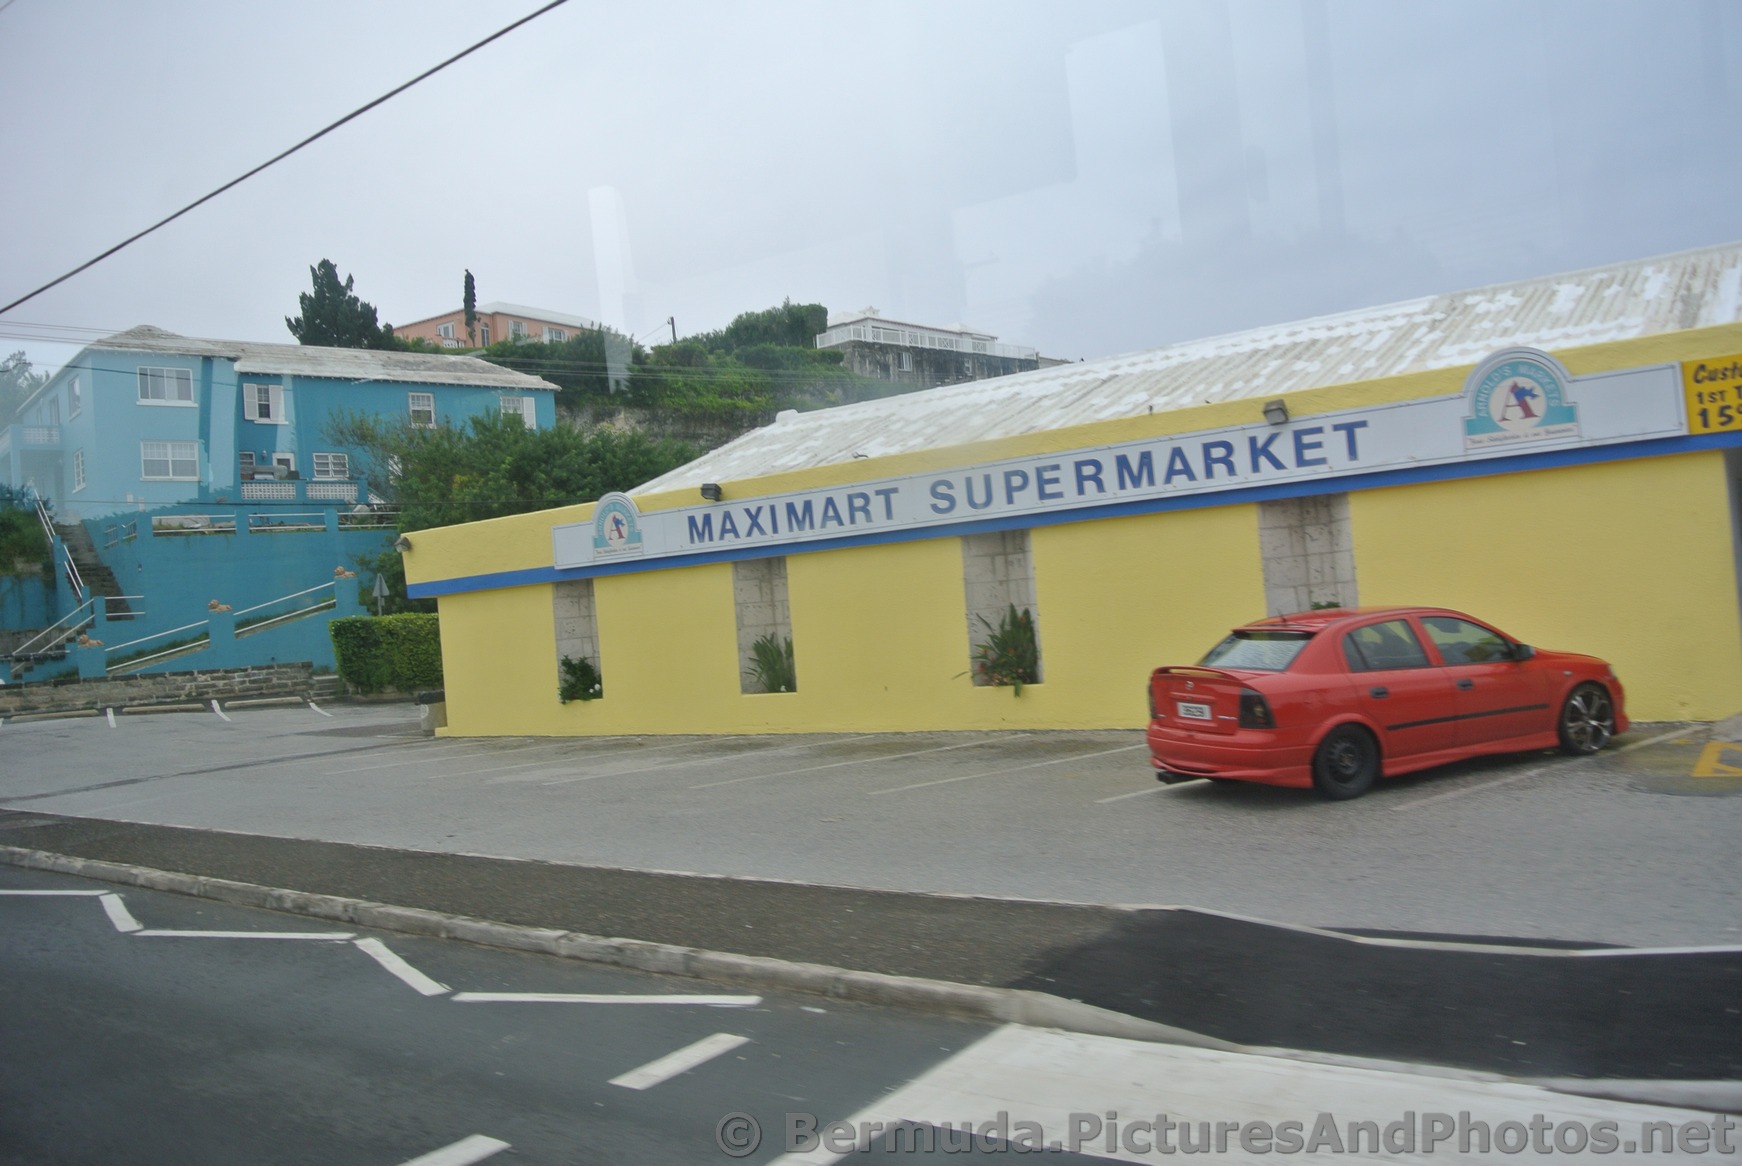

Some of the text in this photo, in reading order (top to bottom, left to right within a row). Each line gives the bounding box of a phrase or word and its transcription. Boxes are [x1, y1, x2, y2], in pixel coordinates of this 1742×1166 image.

[1696, 389, 1726, 404] 1ST
[687, 487, 899, 544] MAXIMART
[929, 420, 1369, 515] SUPERMARKET
